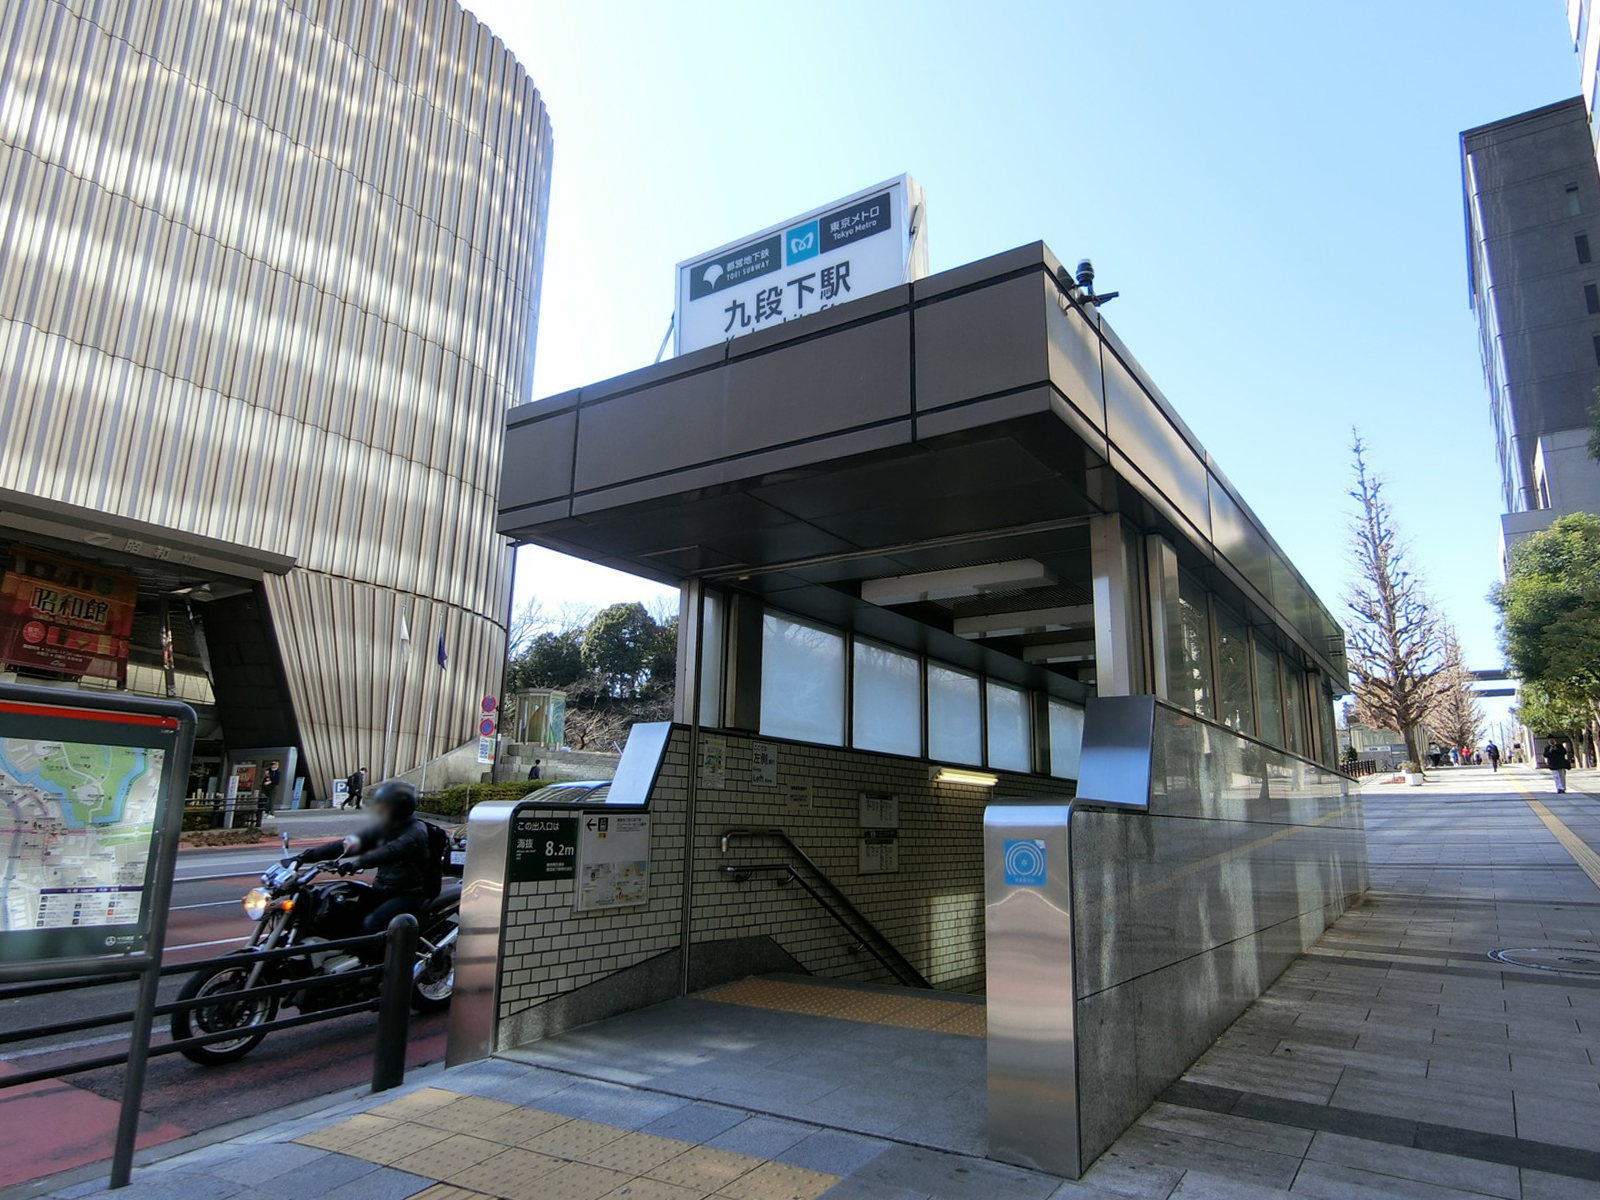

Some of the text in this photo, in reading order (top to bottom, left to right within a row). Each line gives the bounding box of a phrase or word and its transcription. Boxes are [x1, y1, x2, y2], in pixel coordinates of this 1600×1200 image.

[830, 205, 880, 234] 東京メトロ
[832, 220, 877, 241] Tokyo Metro
[726, 248, 770, 272] 都営地下鉄
[726, 260, 770, 281] TOEI SUBWAY
[724, 260, 852, 334] 九段下駅
[32, 586, 109, 624] 昭和館
[337, 783, 346, 792] P
[517, 821, 560, 832] この出入口は
[516, 838, 534, 849] 海抜
[545, 840, 574, 856] 8.2m
